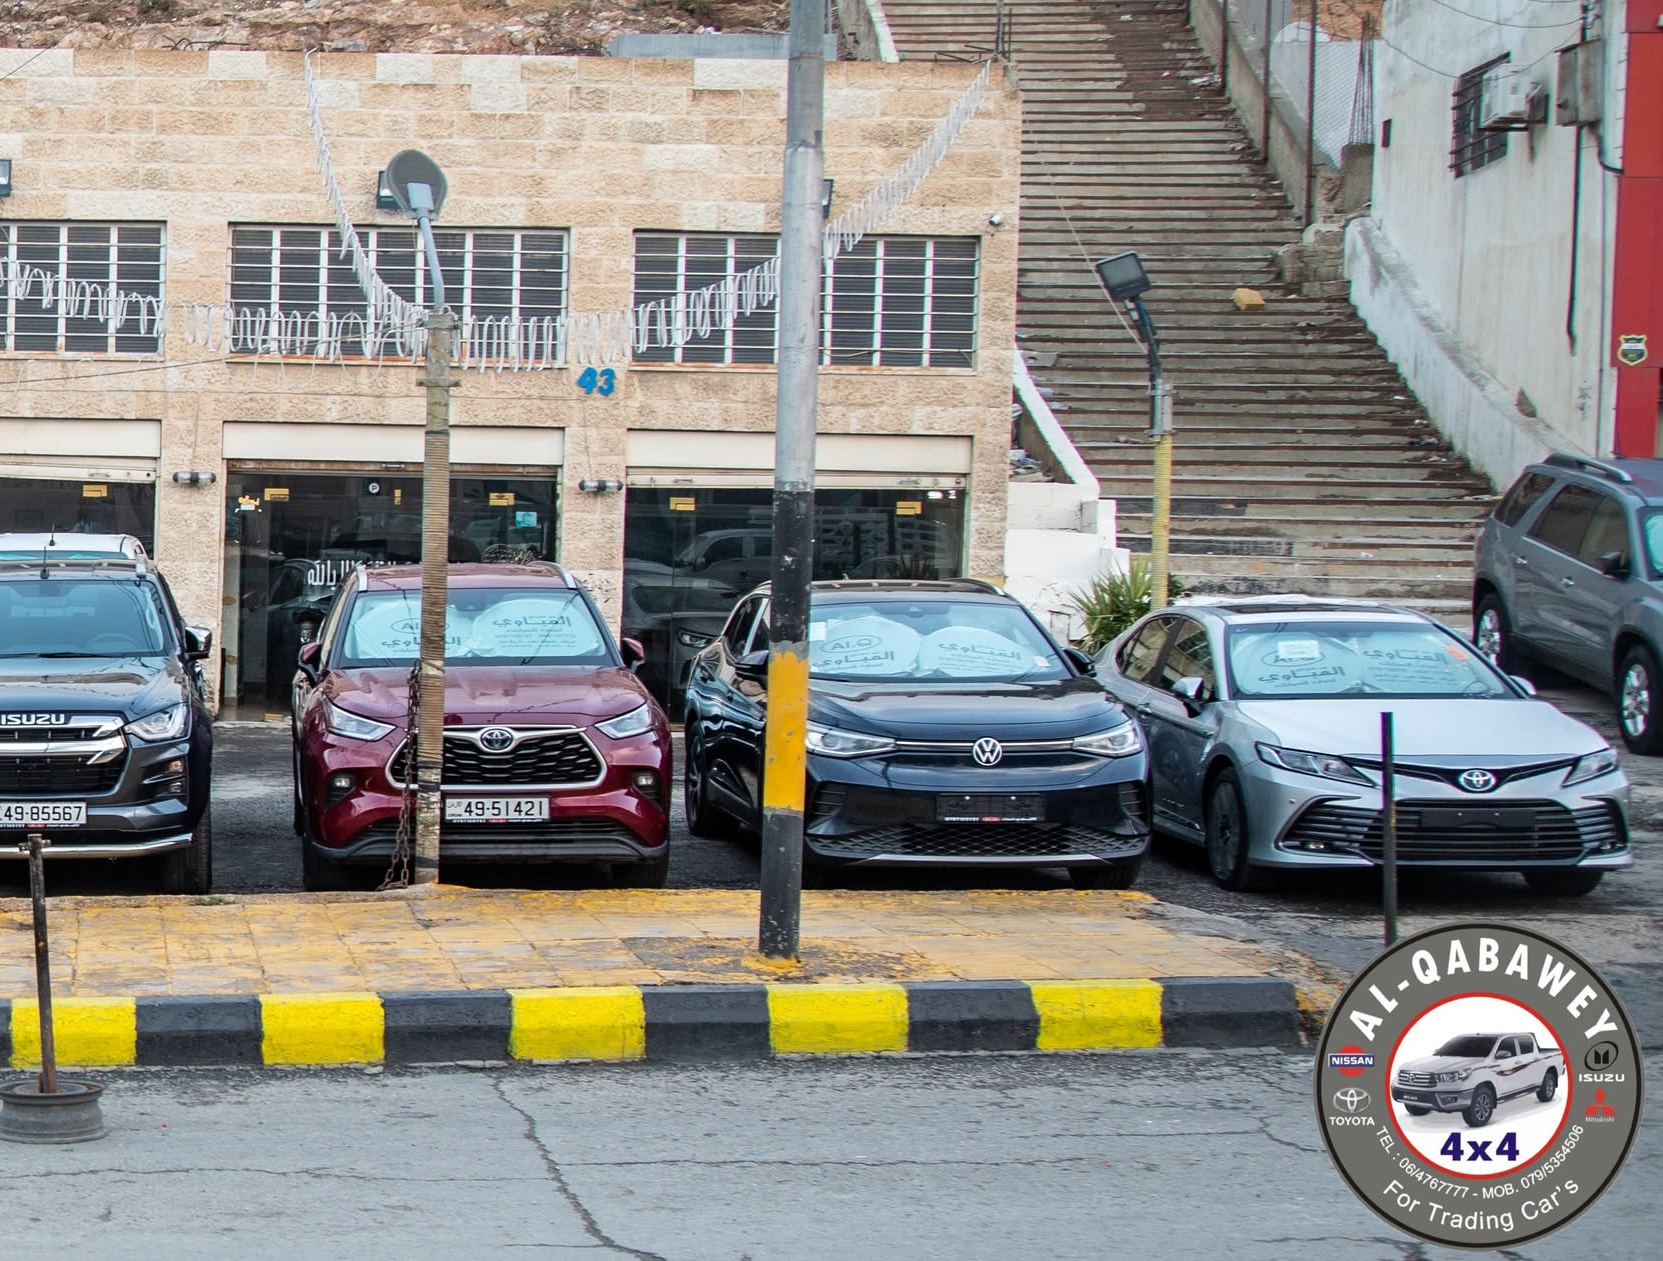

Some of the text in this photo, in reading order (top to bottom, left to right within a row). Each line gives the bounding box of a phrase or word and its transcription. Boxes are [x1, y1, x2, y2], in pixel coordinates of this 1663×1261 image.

[577, 366, 616, 396] 43
[1259, 666, 1346, 683] القباوي
[1, 713, 65, 725] ISUZU
[4, 805, 83, 821] 49-85567
[464, 800, 542, 817] 49-51421
